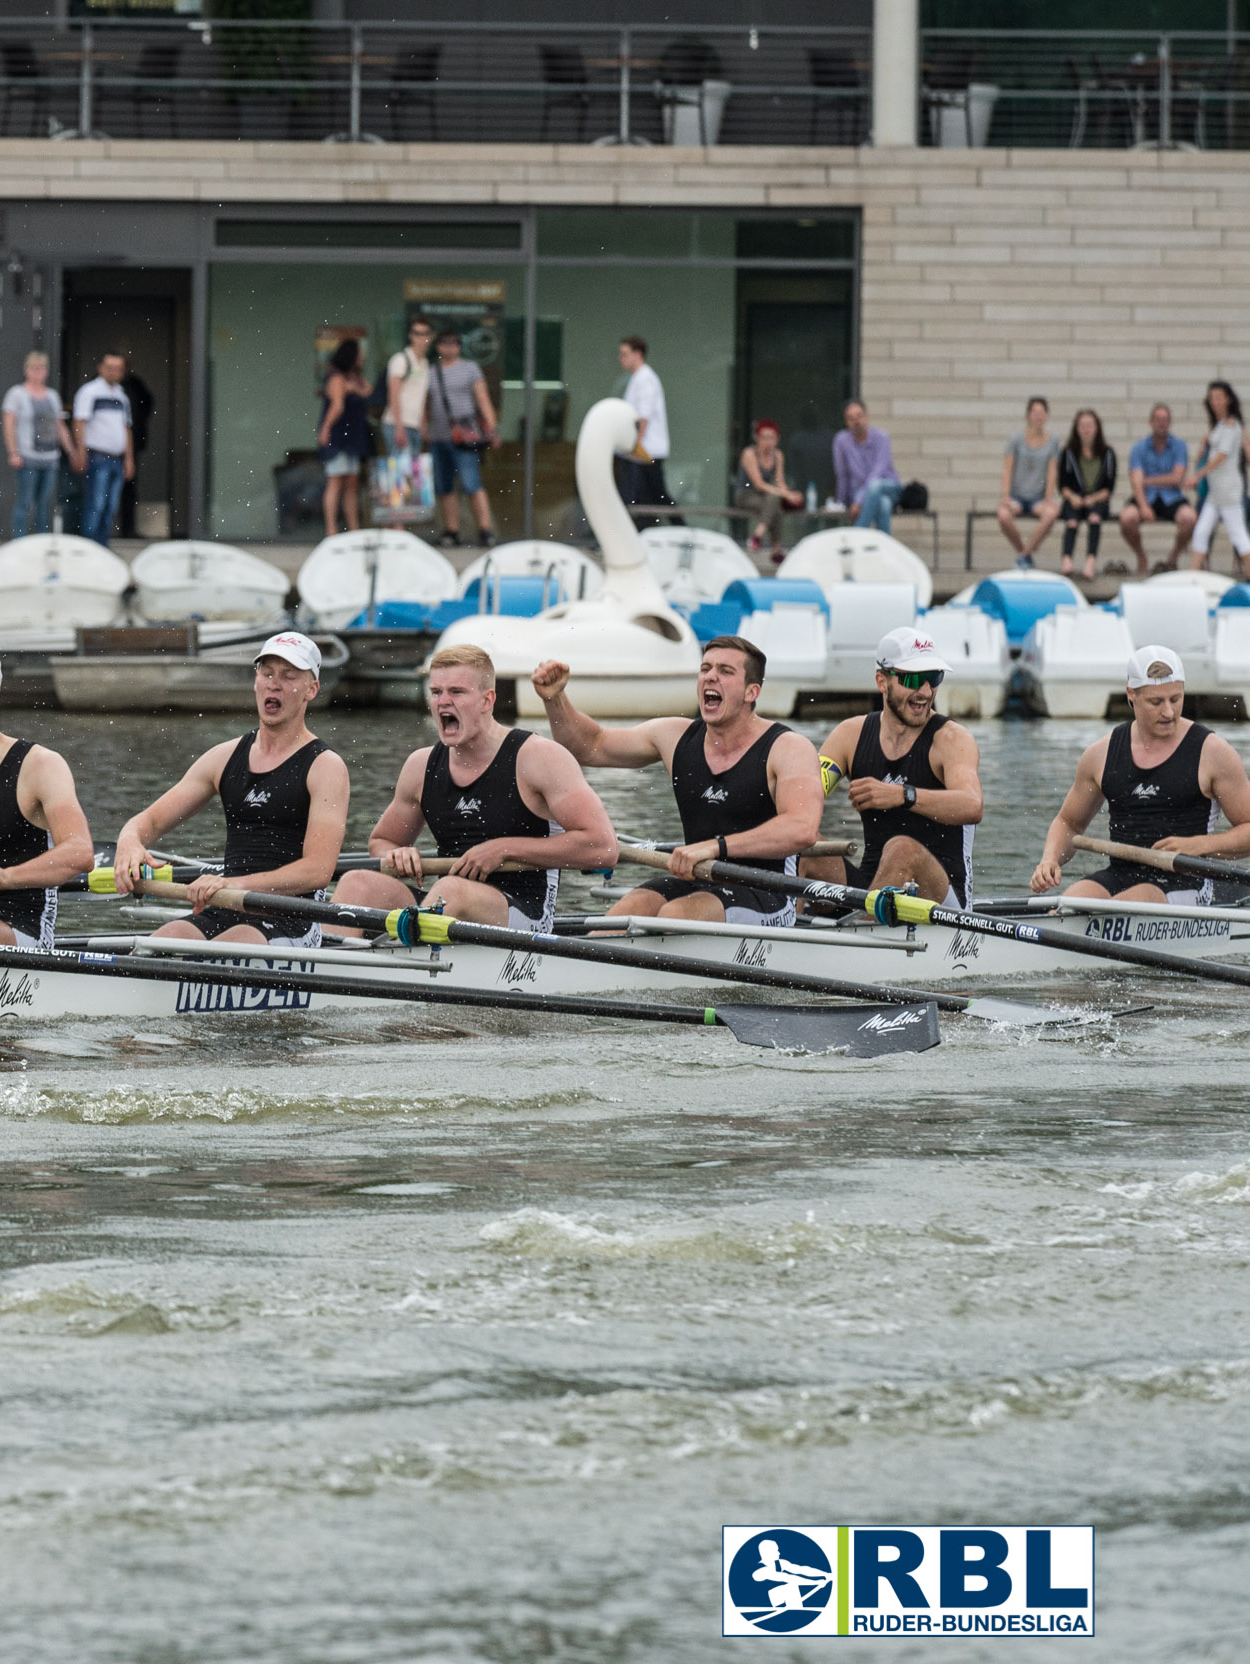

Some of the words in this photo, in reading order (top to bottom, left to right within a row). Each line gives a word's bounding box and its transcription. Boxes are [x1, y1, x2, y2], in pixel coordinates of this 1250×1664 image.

[932, 910, 959, 923] STARK.
[959, 915, 995, 931] SCHNELL.
[995, 922, 1014, 934] GUT.
[1018, 925, 1039, 937] RBL
[1102, 917, 1132, 942] RBL
[1135, 919, 1230, 941] RUDER-BUNDESLIGA
